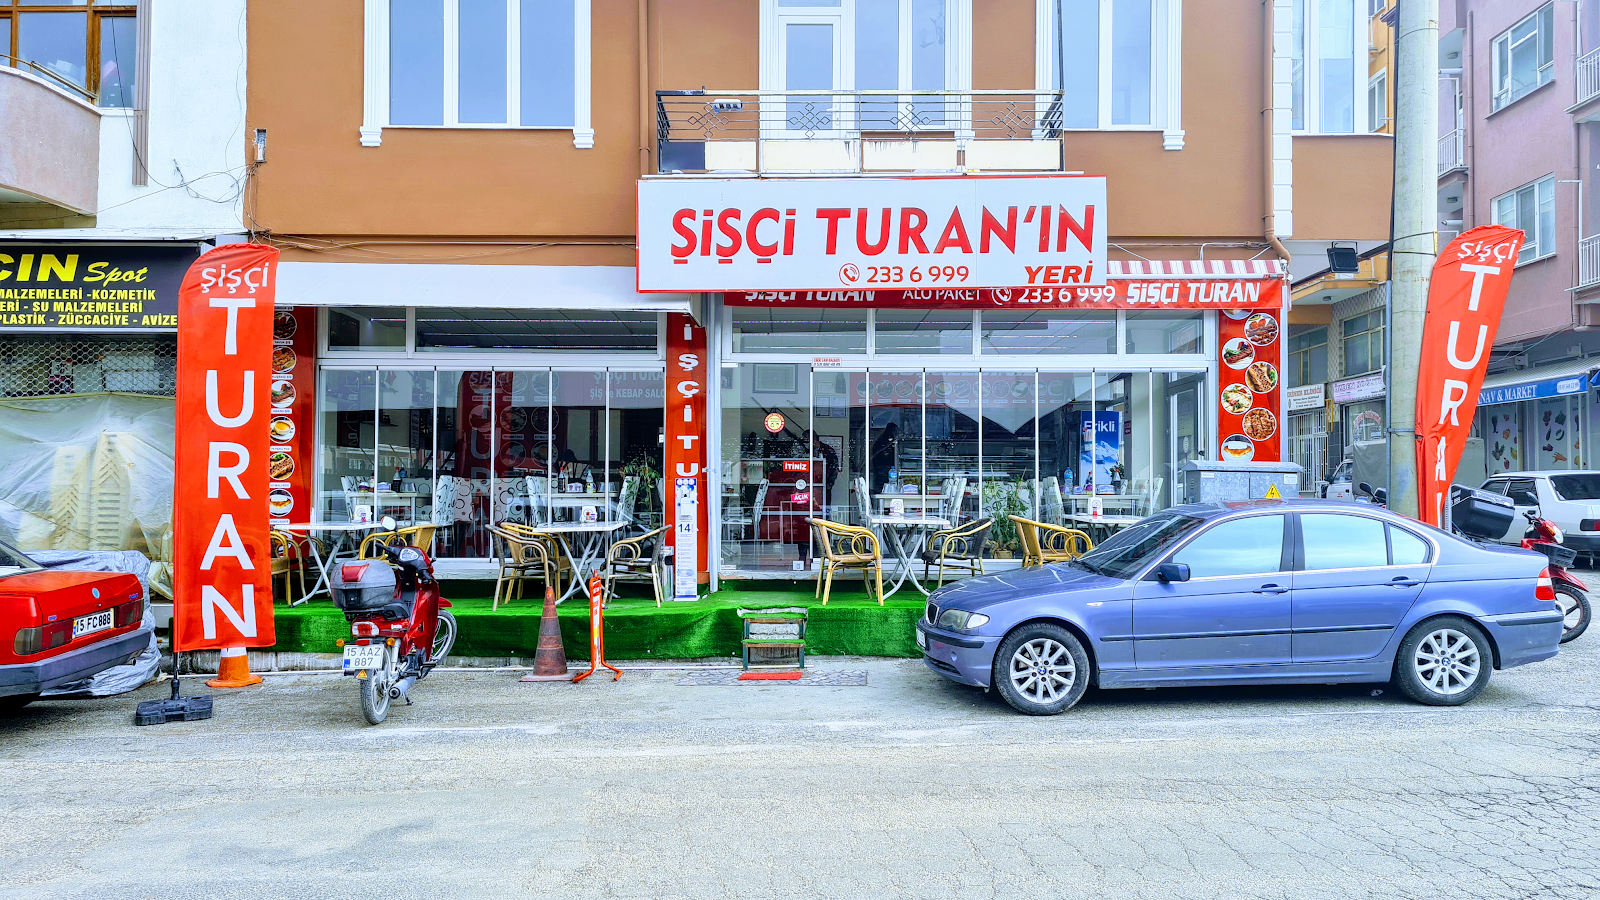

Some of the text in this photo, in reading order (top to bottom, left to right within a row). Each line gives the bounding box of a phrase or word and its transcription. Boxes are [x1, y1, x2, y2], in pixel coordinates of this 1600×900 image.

[816, 204, 1095, 256] TURAN'IN
[83, 261, 149, 287] Spot
[866, 265, 970, 283] 233 6 999
[1024, 259, 1094, 284] YERİ
[1018, 289, 1054, 303] 233
[1058, 288, 1072, 303] 6
[1076, 286, 1116, 303] 999
[1187, 283, 1261, 303] TURAN
[33, 302, 49, 312] SU
[53, 301, 143, 313] MALZEMELERİ
[58, 313, 129, 326] ZÜCCACİYE
[142, 314, 178, 326] AVİZE
[616, 388, 643, 398] KEBAP
[1497, 390, 1503, 402] &
[1505, 385, 1537, 401] MARKET
[200, 297, 258, 640] TURAN
[679, 523, 690, 533] 14
[76, 619, 84, 632] 15
[346, 648, 381, 657] 15 AAZ
[354, 658, 373, 667] 887
